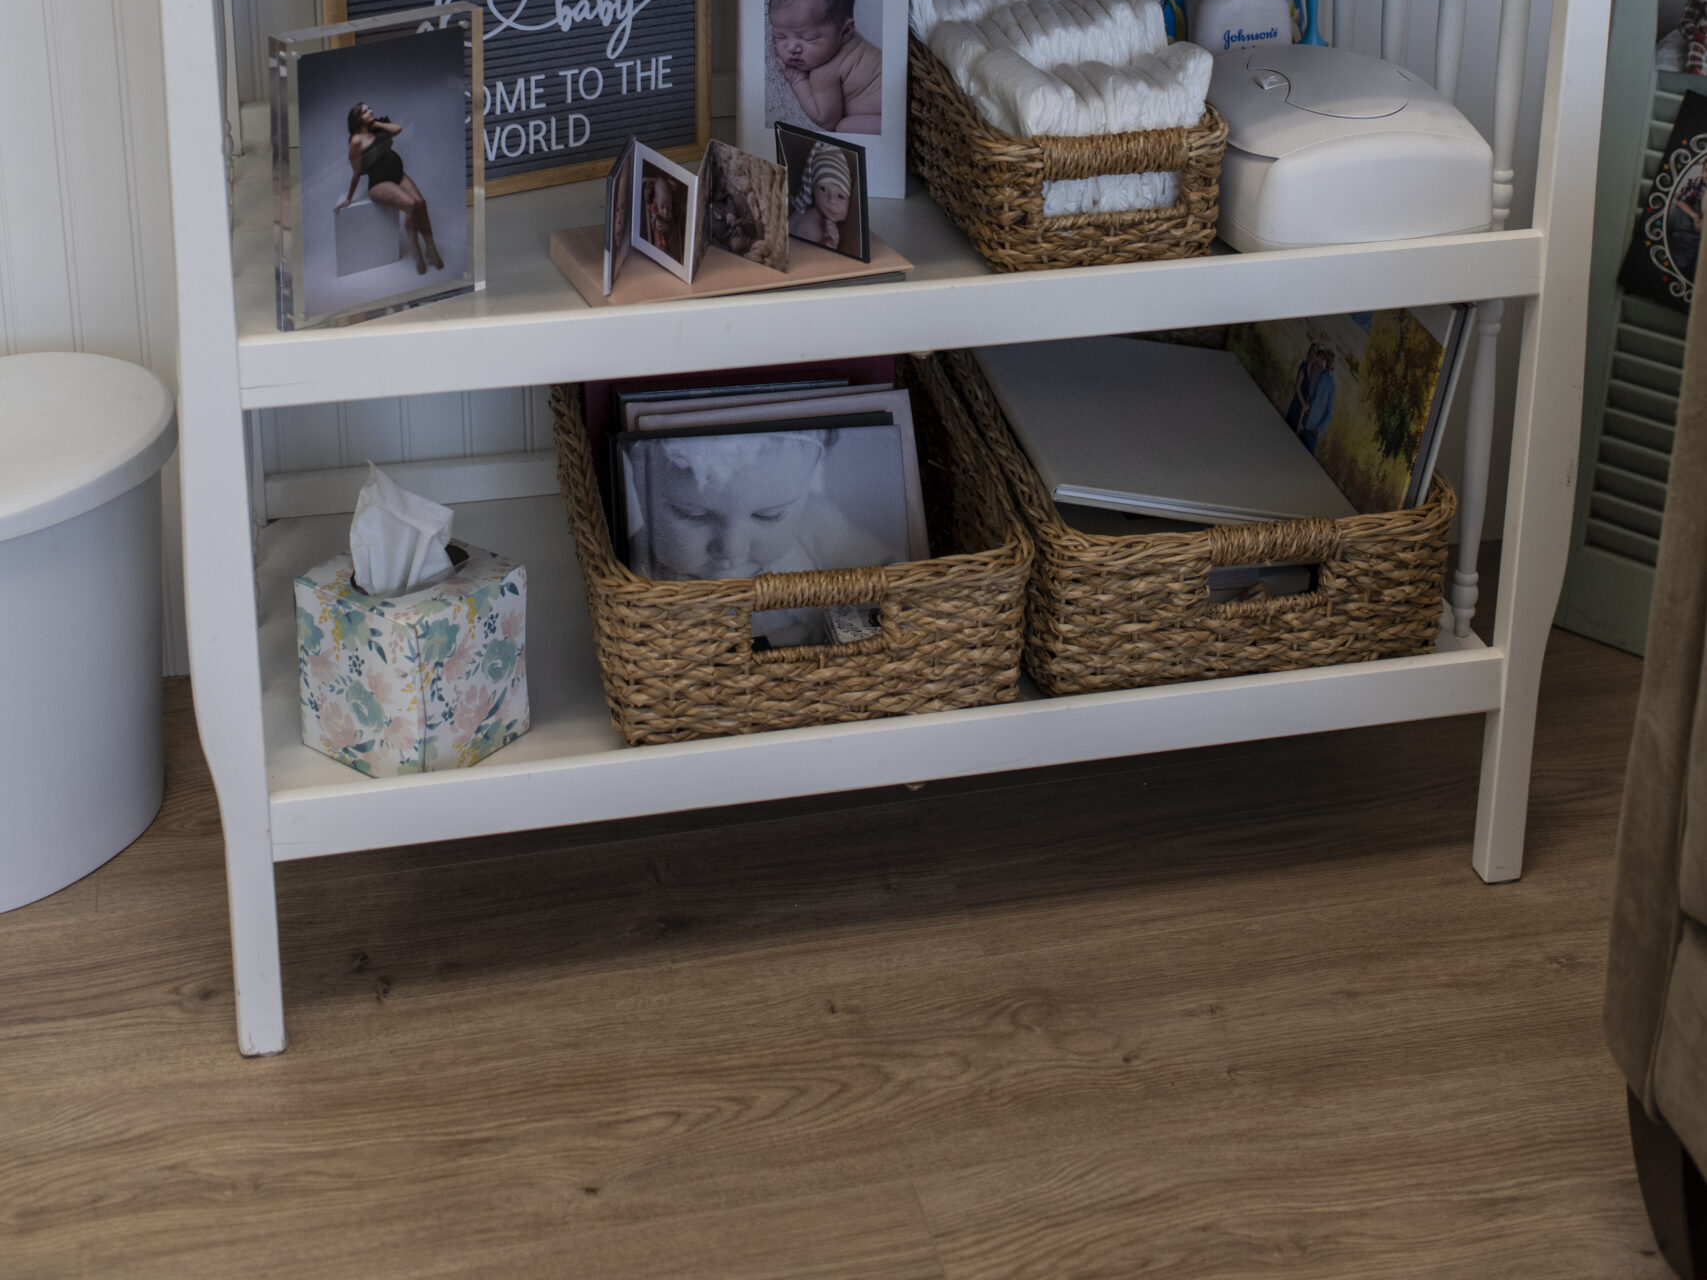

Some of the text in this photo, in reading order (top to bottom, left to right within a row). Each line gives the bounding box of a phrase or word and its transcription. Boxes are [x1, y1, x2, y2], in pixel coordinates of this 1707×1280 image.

[1223, 27, 1279, 50] Johnson's
[558, 67, 604, 104] TO
[614, 55, 673, 95] THE
